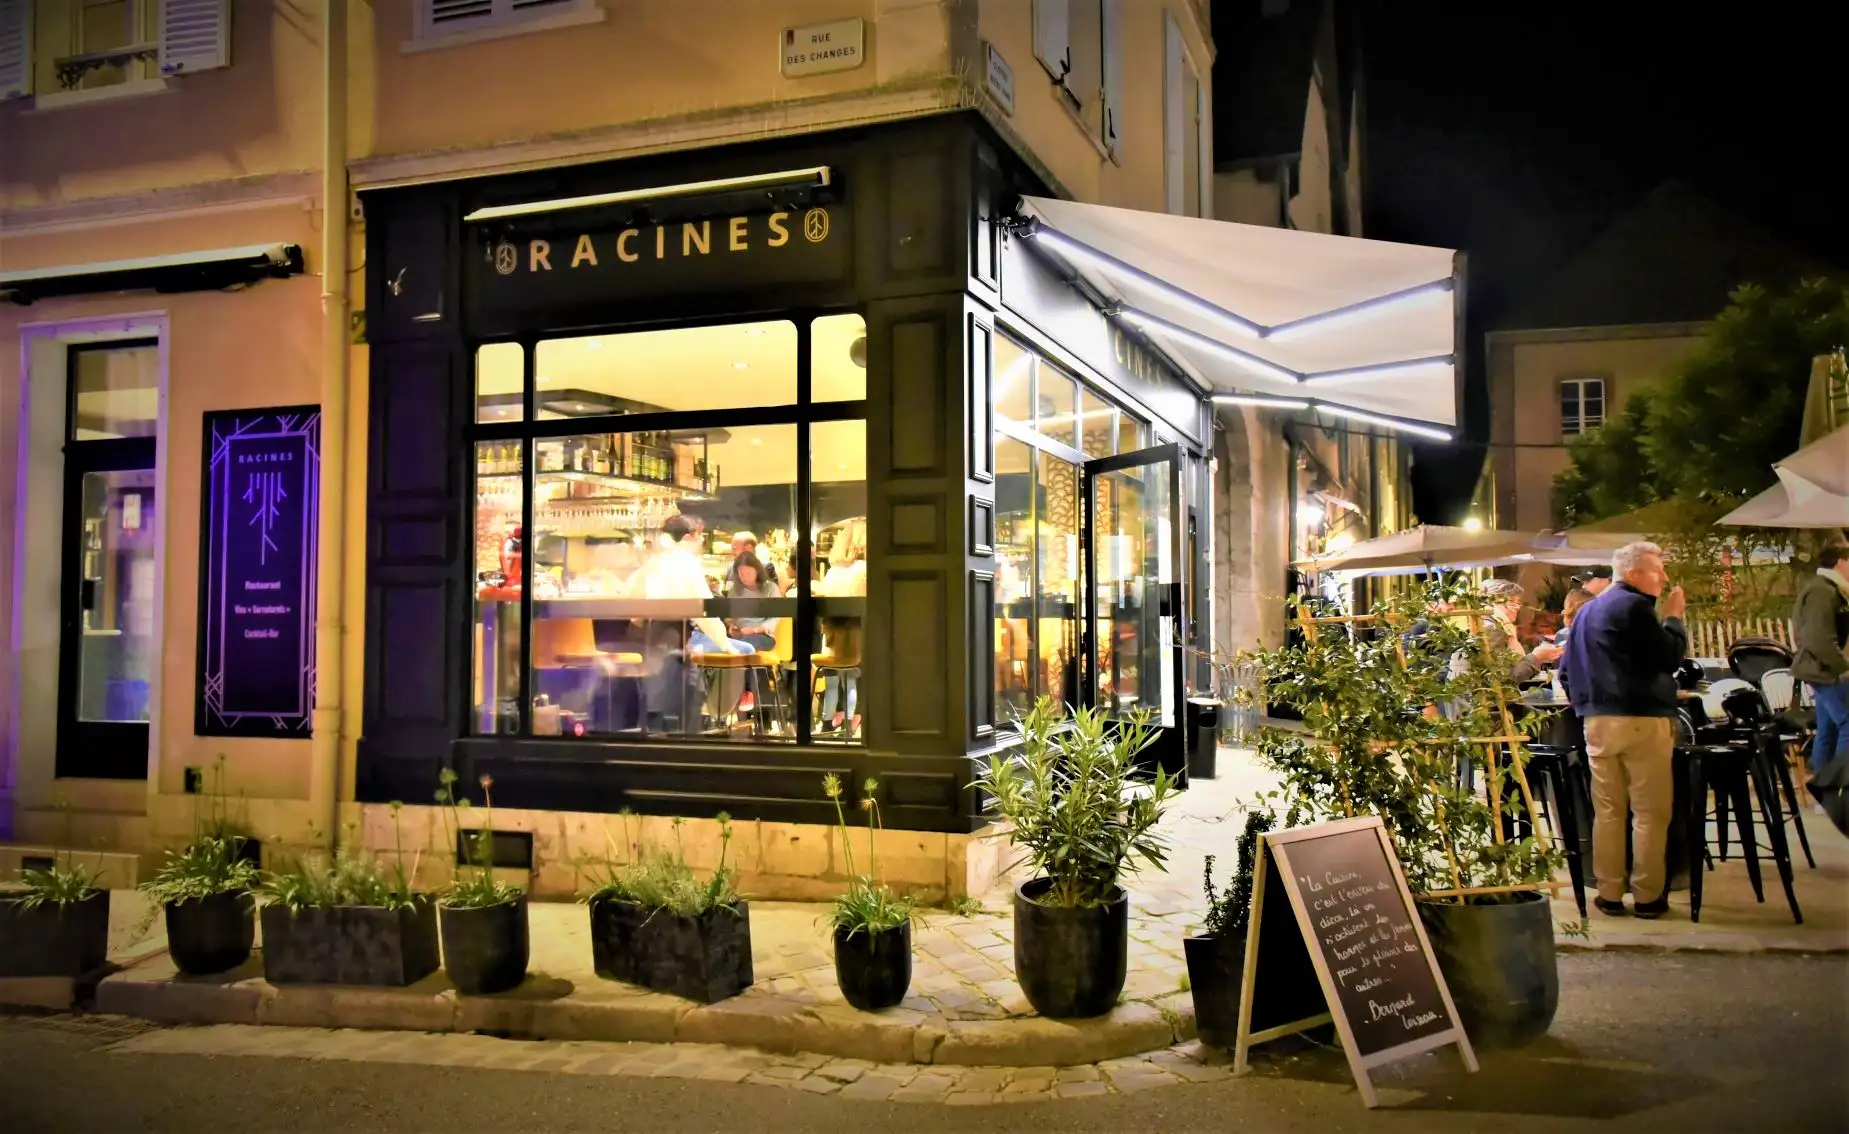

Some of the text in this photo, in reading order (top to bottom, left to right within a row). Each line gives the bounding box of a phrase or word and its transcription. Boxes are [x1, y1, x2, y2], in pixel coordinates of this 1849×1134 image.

[811, 33, 831, 44] RUE
[787, 46, 856, 65] DES CHANGES
[529, 211, 790, 272] RACINES
[238, 451, 293, 464] RACINES
